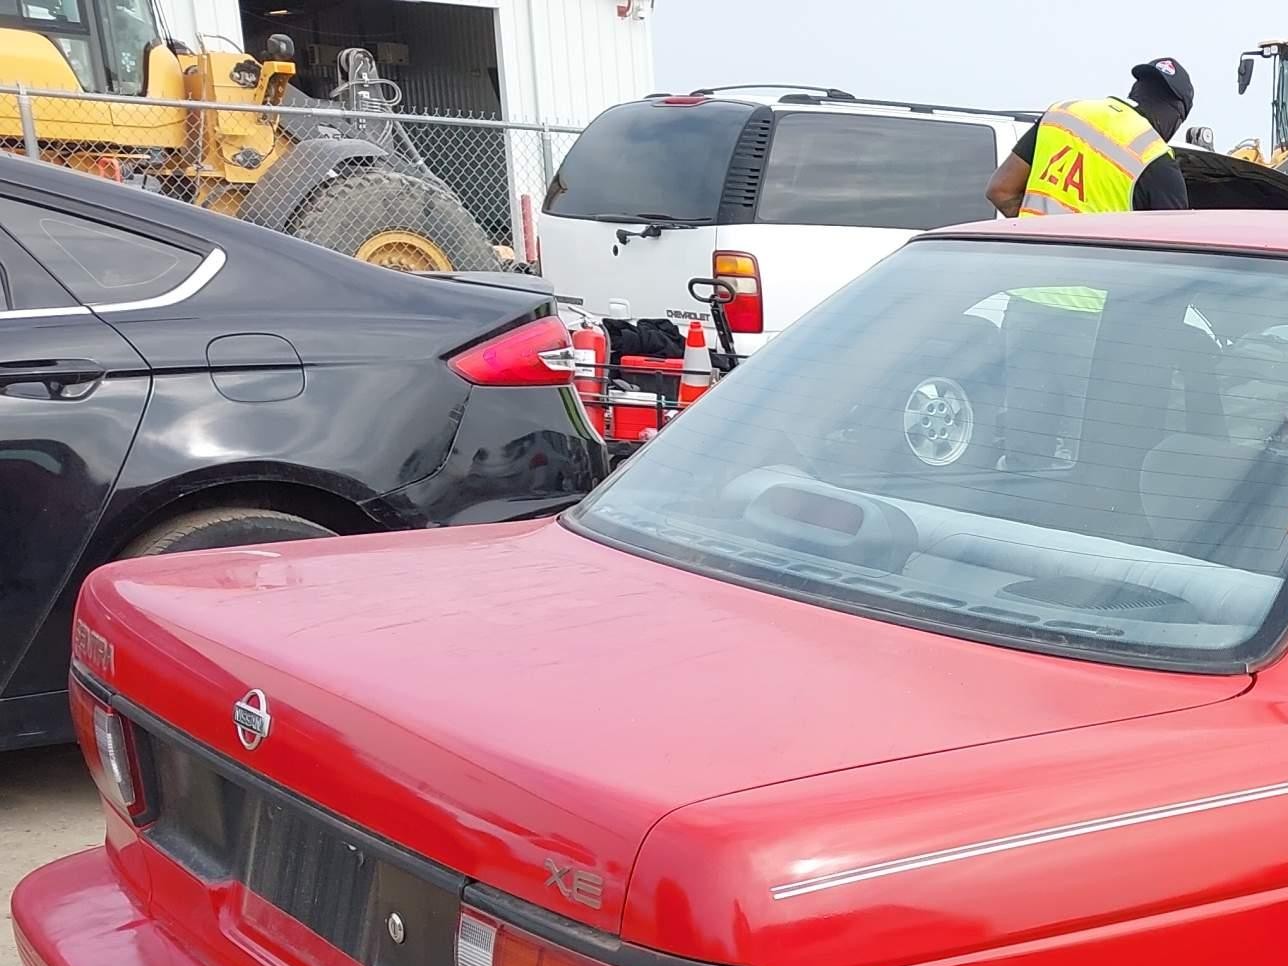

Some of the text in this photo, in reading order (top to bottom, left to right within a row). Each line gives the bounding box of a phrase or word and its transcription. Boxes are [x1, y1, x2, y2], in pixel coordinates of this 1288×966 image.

[666, 309, 711, 322] CHEVROLET
[234, 704, 267, 734] NISSAN
[543, 857, 605, 911] XE
